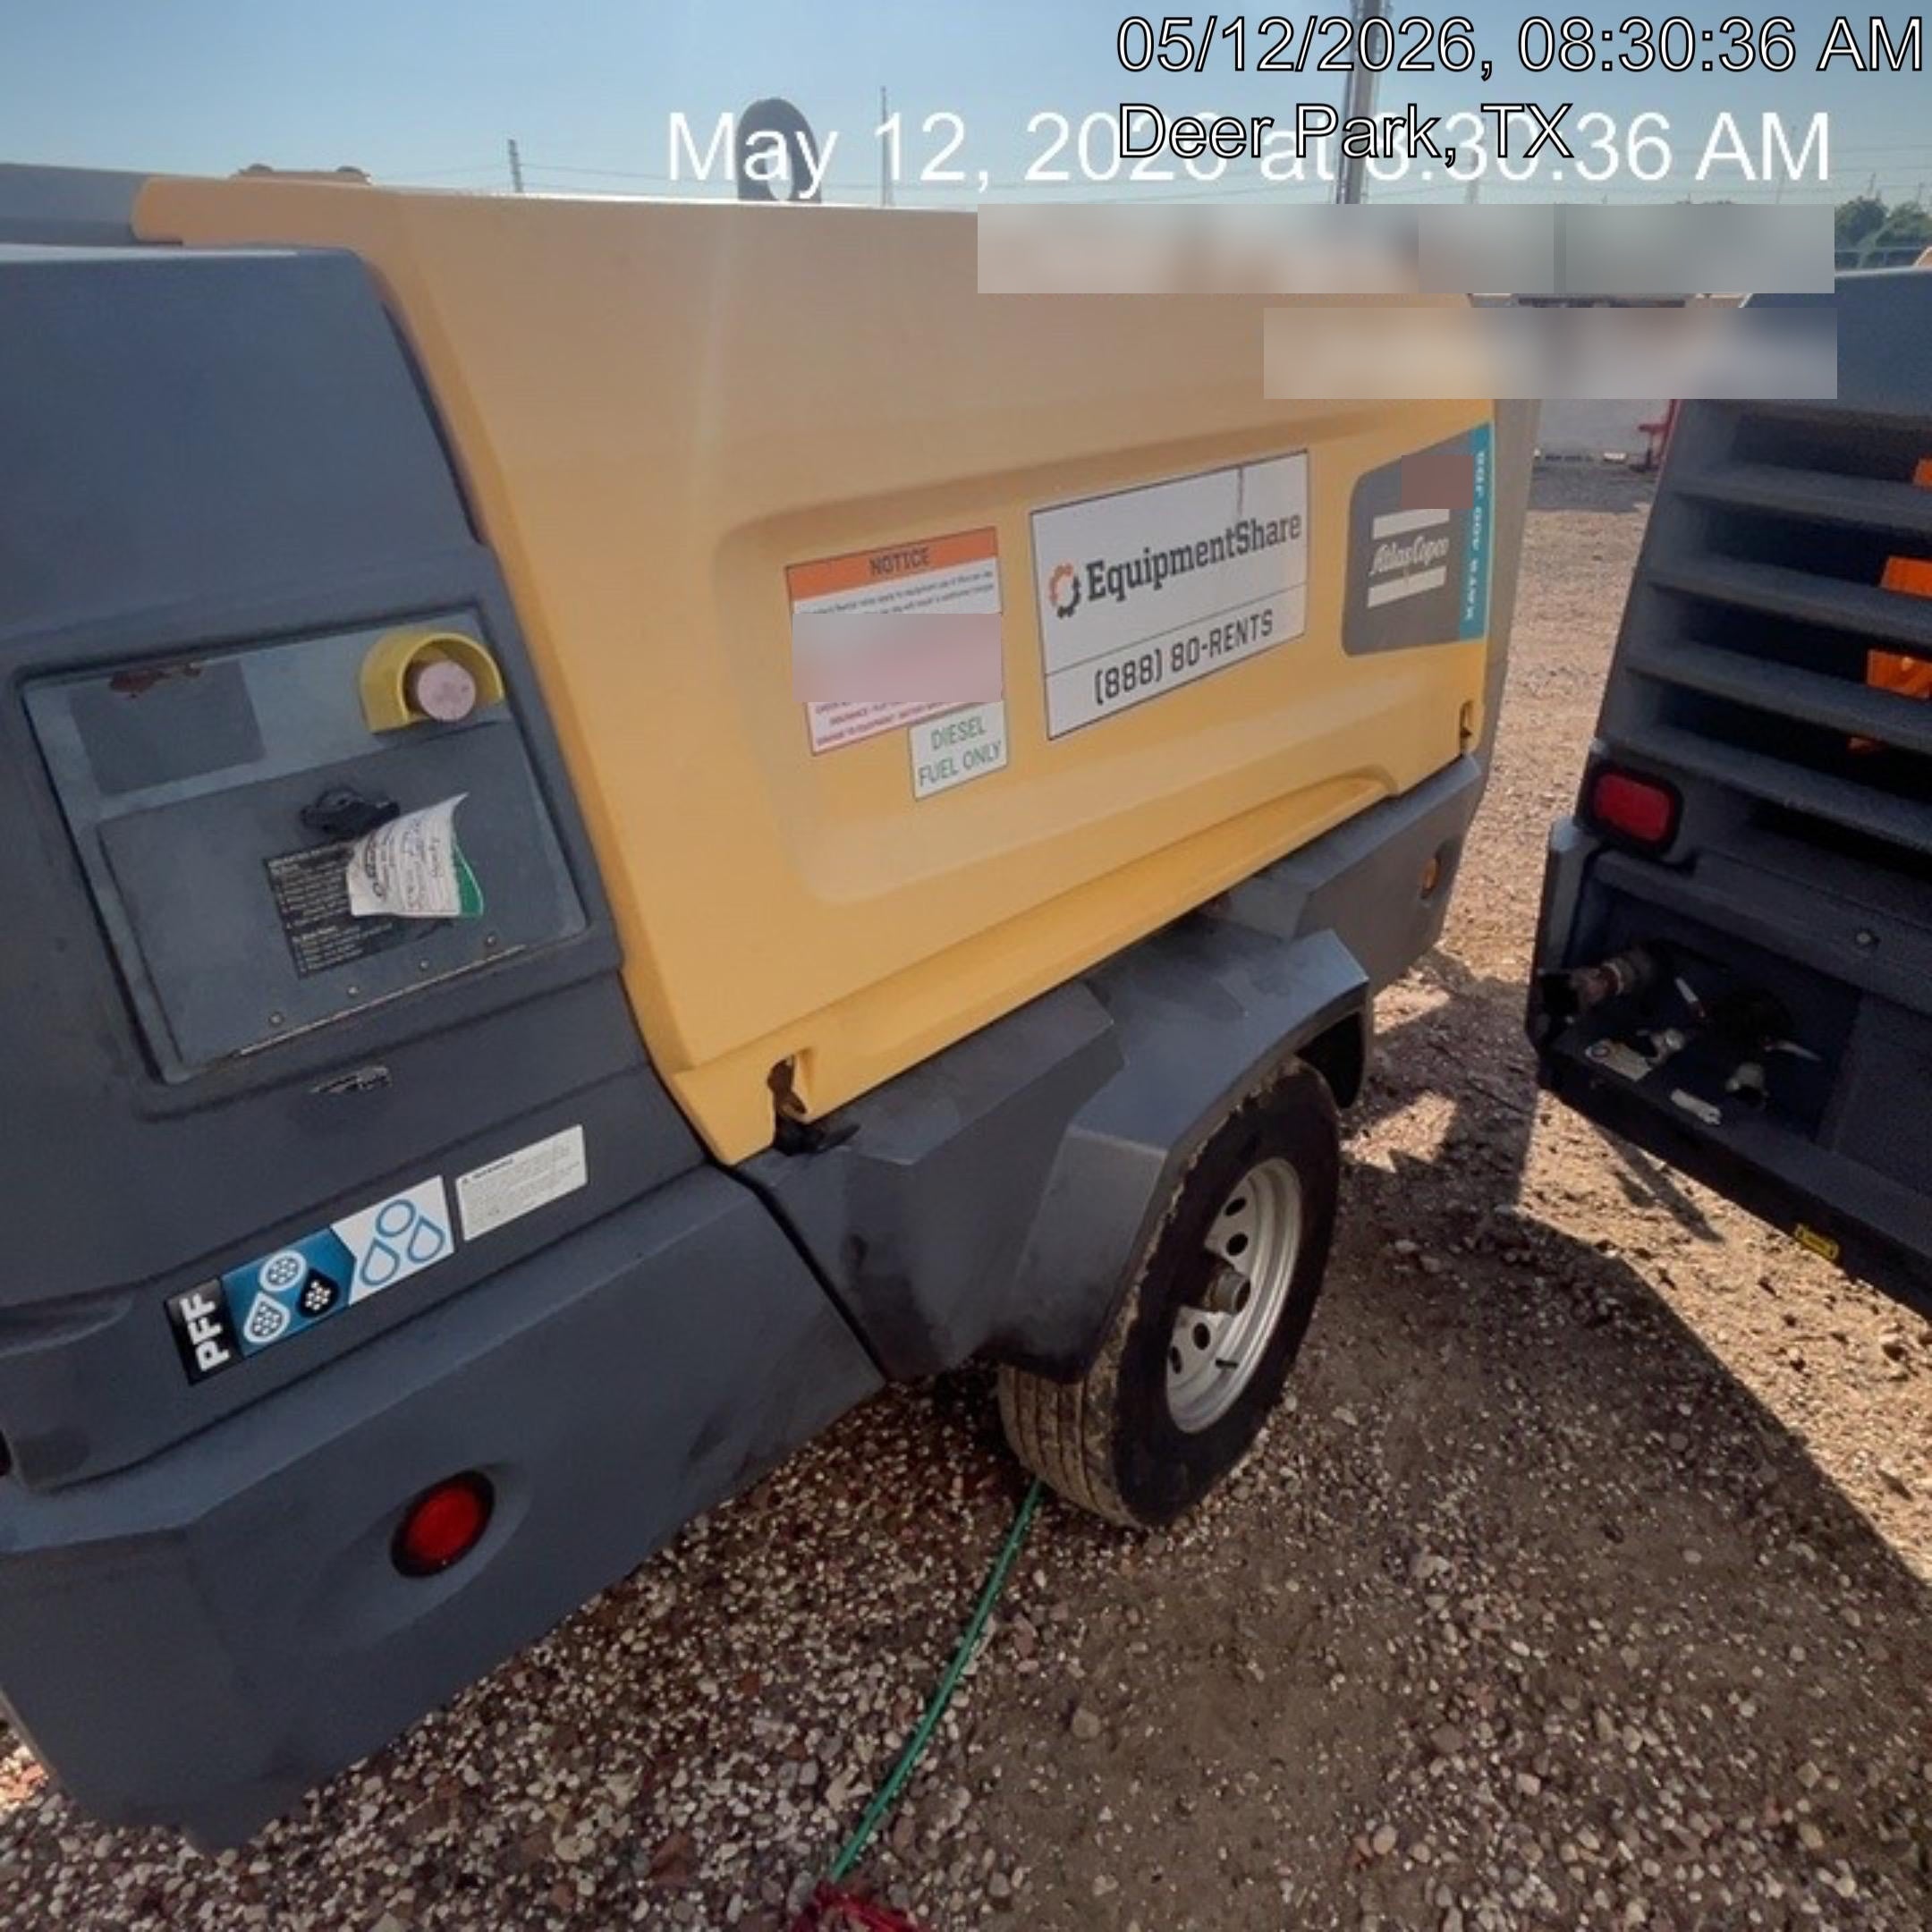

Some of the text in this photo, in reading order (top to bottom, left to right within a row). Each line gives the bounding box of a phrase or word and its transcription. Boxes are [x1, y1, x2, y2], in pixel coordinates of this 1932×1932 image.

[869, 547, 931, 575] NOTICE
[1085, 513, 1301, 603] EquipmentShare
[1094, 608, 1273, 705] (888) 80-RENTS
[917, 741, 1003, 787] FUEL ONLY
[930, 716, 987, 750] DIESEL
[180, 1292, 230, 1371] PFF
